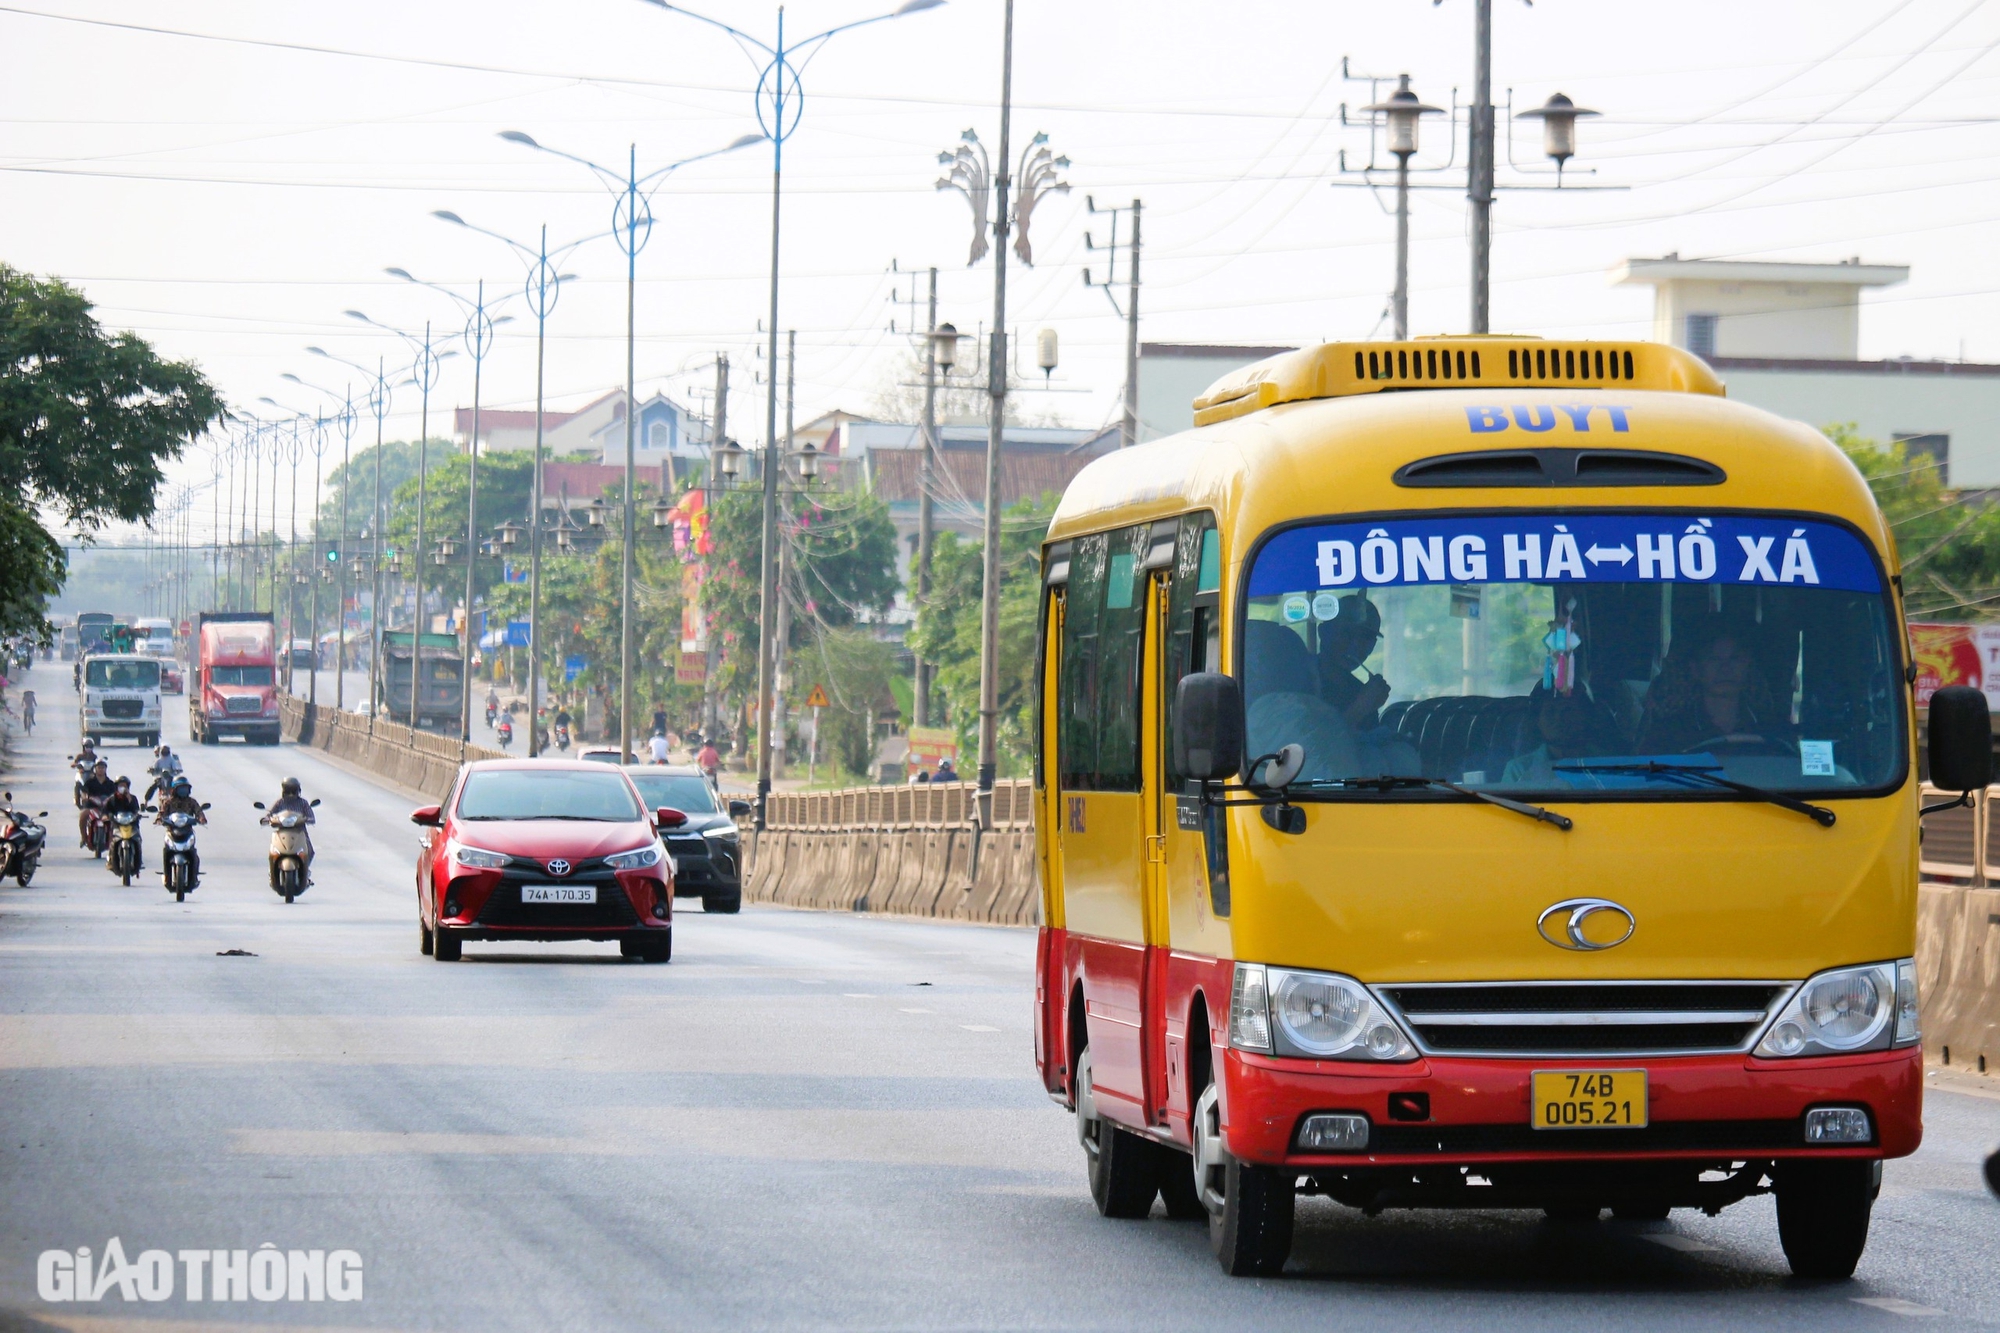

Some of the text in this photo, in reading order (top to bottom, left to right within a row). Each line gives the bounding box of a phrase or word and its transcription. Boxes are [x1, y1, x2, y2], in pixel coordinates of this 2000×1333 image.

[1316, 517, 1822, 586] ĐÔNG HÀ HỒ XÁ
[1566, 1074, 1614, 1098] 74B
[1546, 1101, 1631, 1125] 005.21
